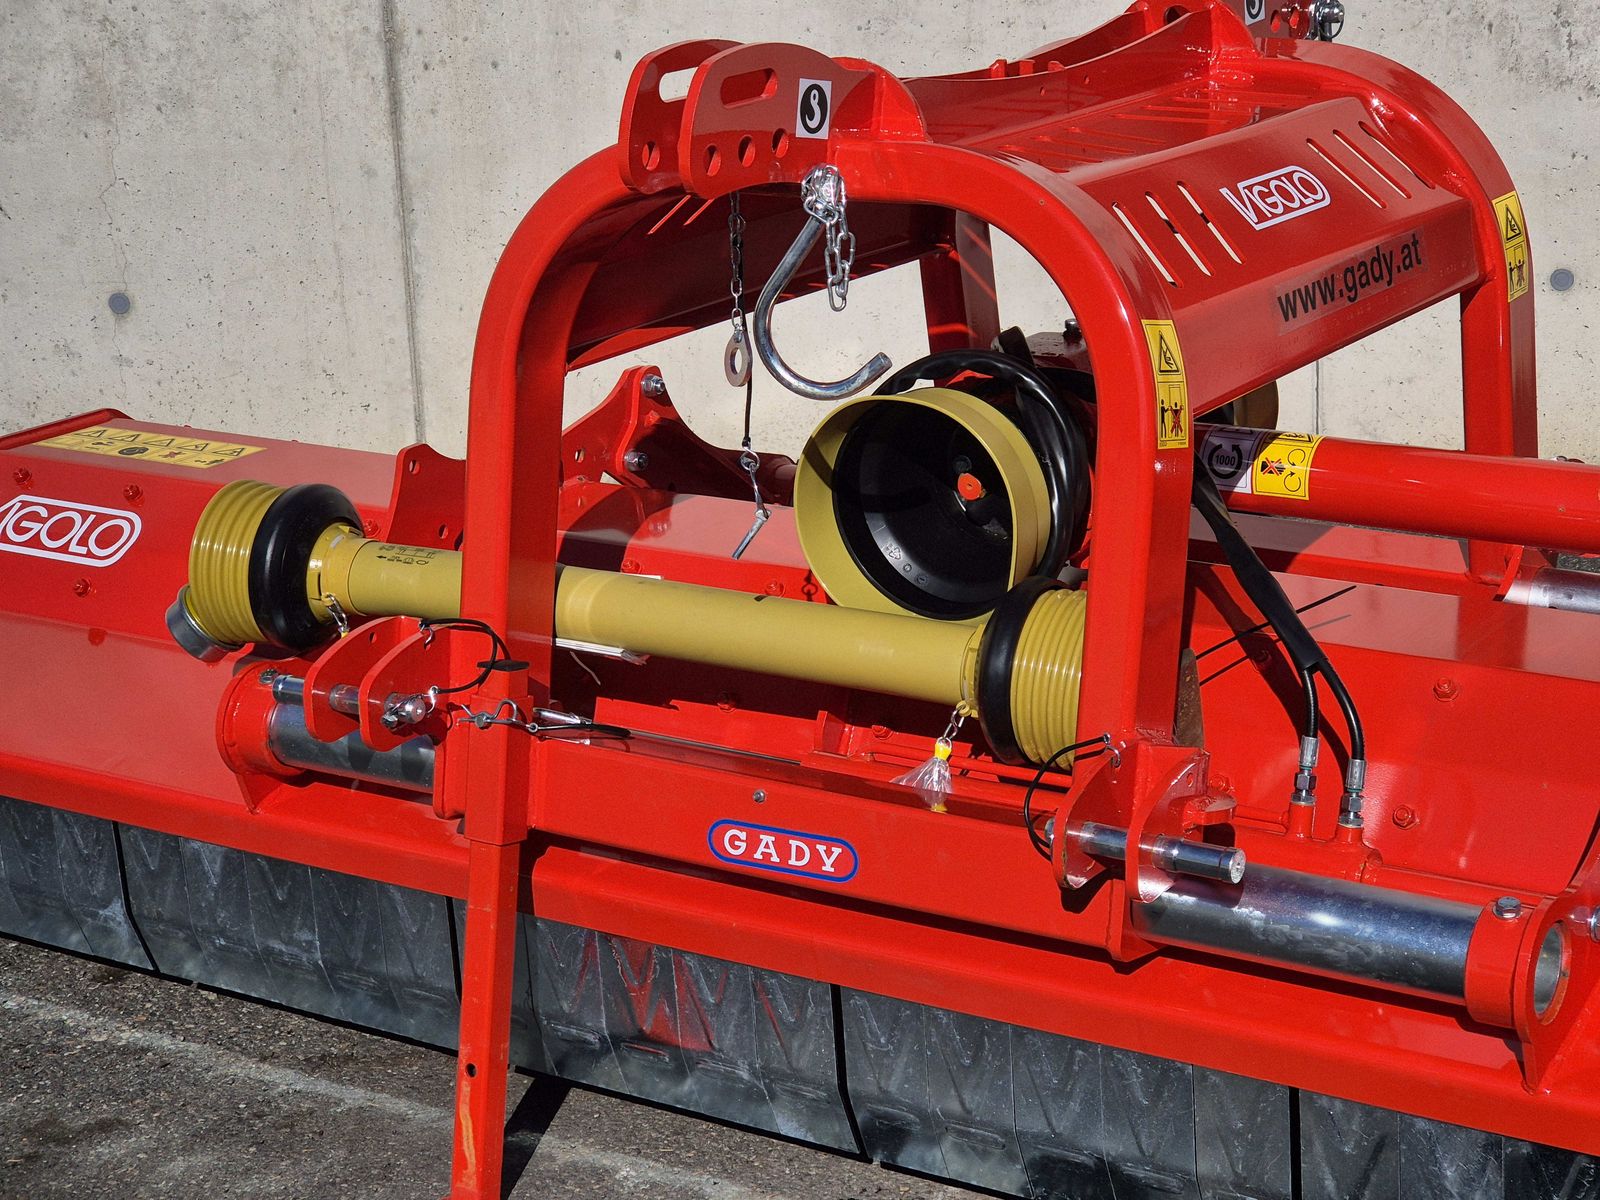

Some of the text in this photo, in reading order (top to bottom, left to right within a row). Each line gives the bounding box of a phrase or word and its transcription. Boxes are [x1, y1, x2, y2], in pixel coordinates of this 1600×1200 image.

[1219, 171, 1326, 226] VIGOLO
[1277, 233, 1422, 322] www.gady.at
[1215, 454, 1236, 467] 1000
[0, 500, 131, 557] IGOLO
[723, 829, 842, 872] GADY
